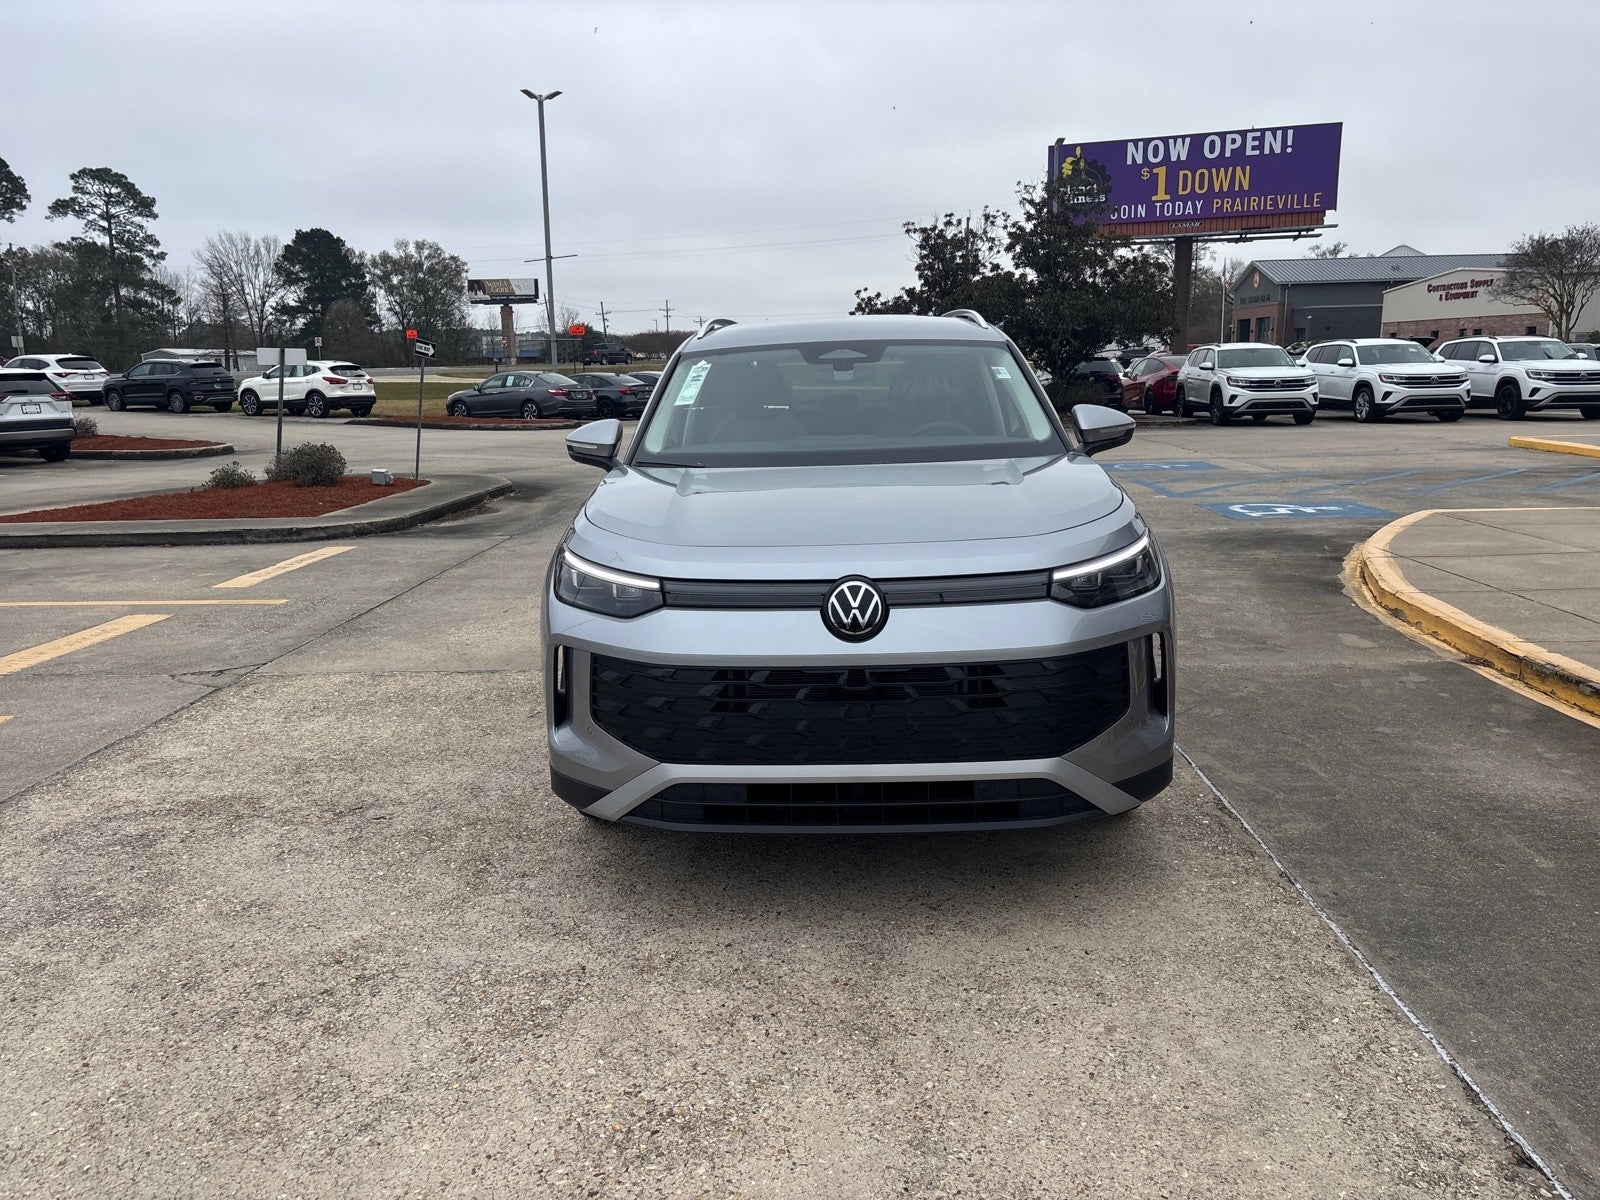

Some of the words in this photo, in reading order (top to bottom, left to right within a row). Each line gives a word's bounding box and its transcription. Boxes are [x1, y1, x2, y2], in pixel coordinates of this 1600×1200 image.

[1126, 137, 1191, 165] NOW
[1203, 129, 1294, 159] OPEN!
[1178, 166, 1251, 195] DOWN
[1110, 204, 1146, 220] JOIN
[1155, 200, 1203, 217] TODAY
[1212, 192, 1322, 213] PRAIRIEVILLE
